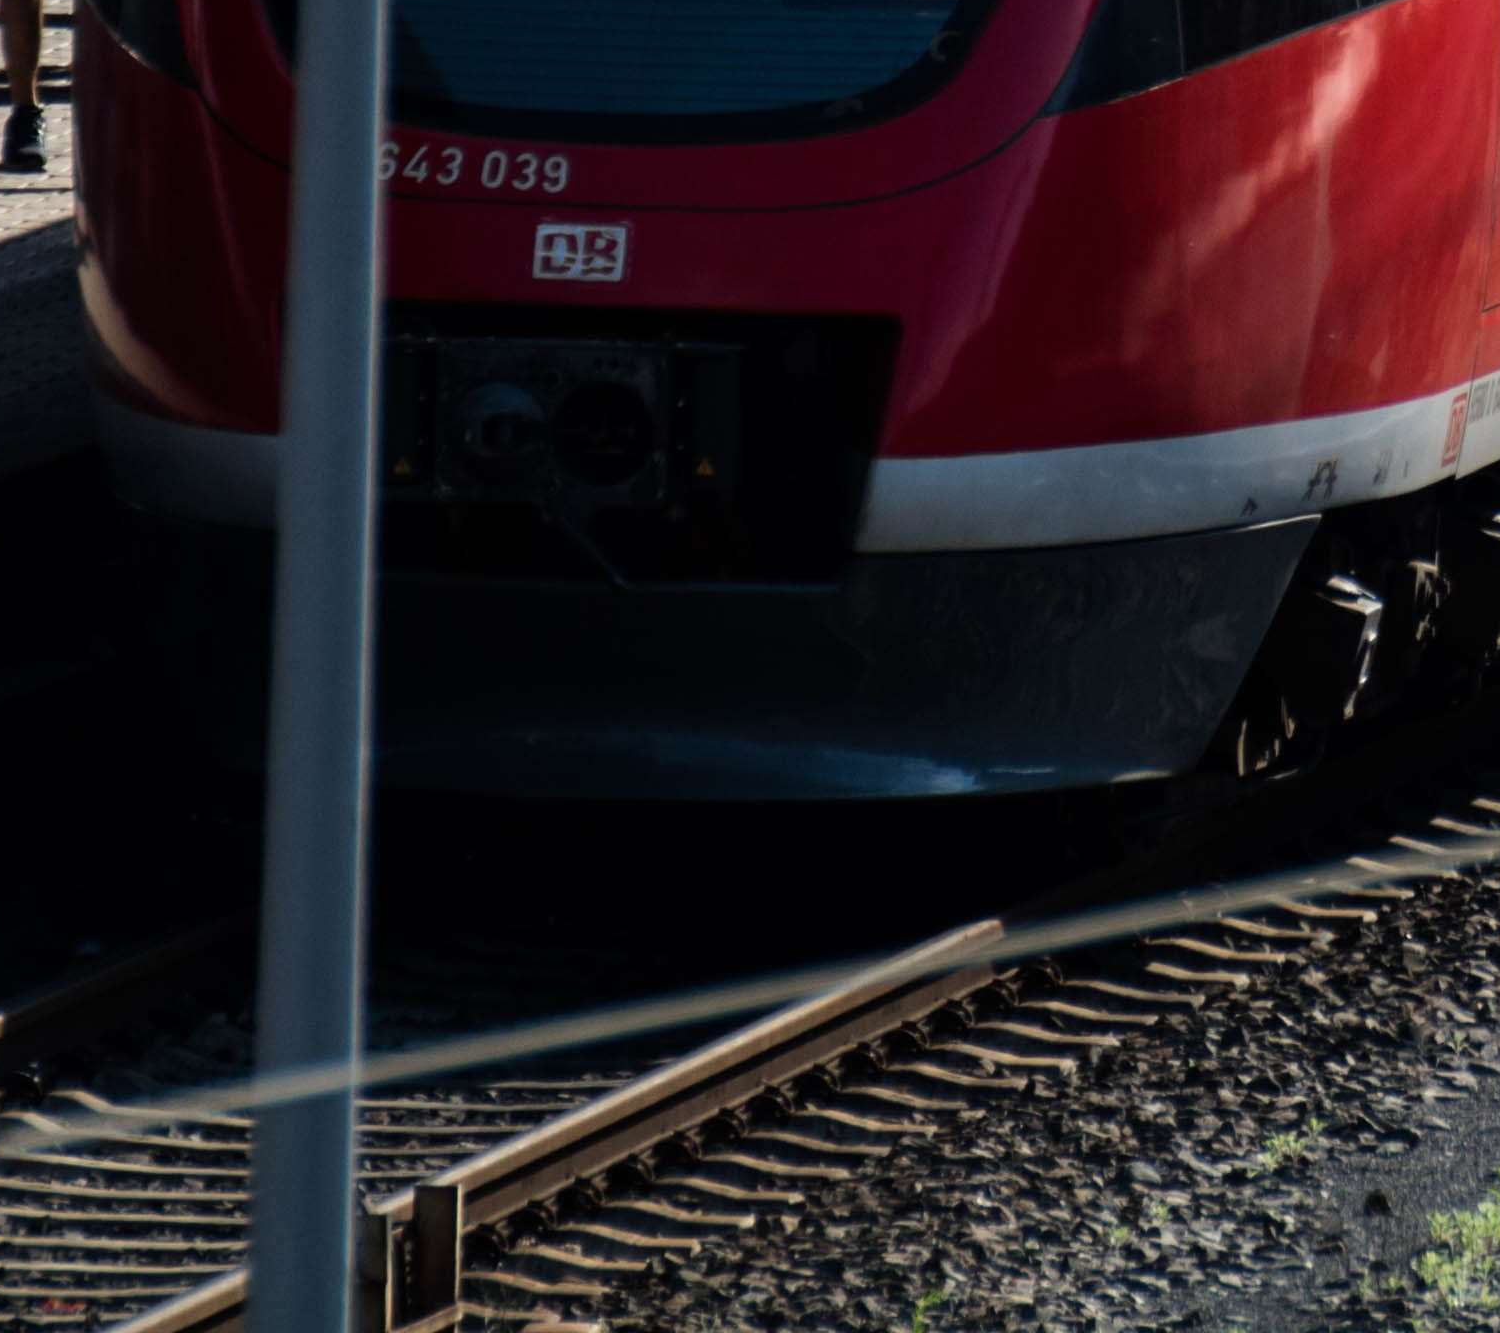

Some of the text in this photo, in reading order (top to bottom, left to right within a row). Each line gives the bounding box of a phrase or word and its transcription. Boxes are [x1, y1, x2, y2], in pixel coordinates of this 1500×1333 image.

[377, 142, 571, 194] 643 039
[538, 227, 622, 278] DB
